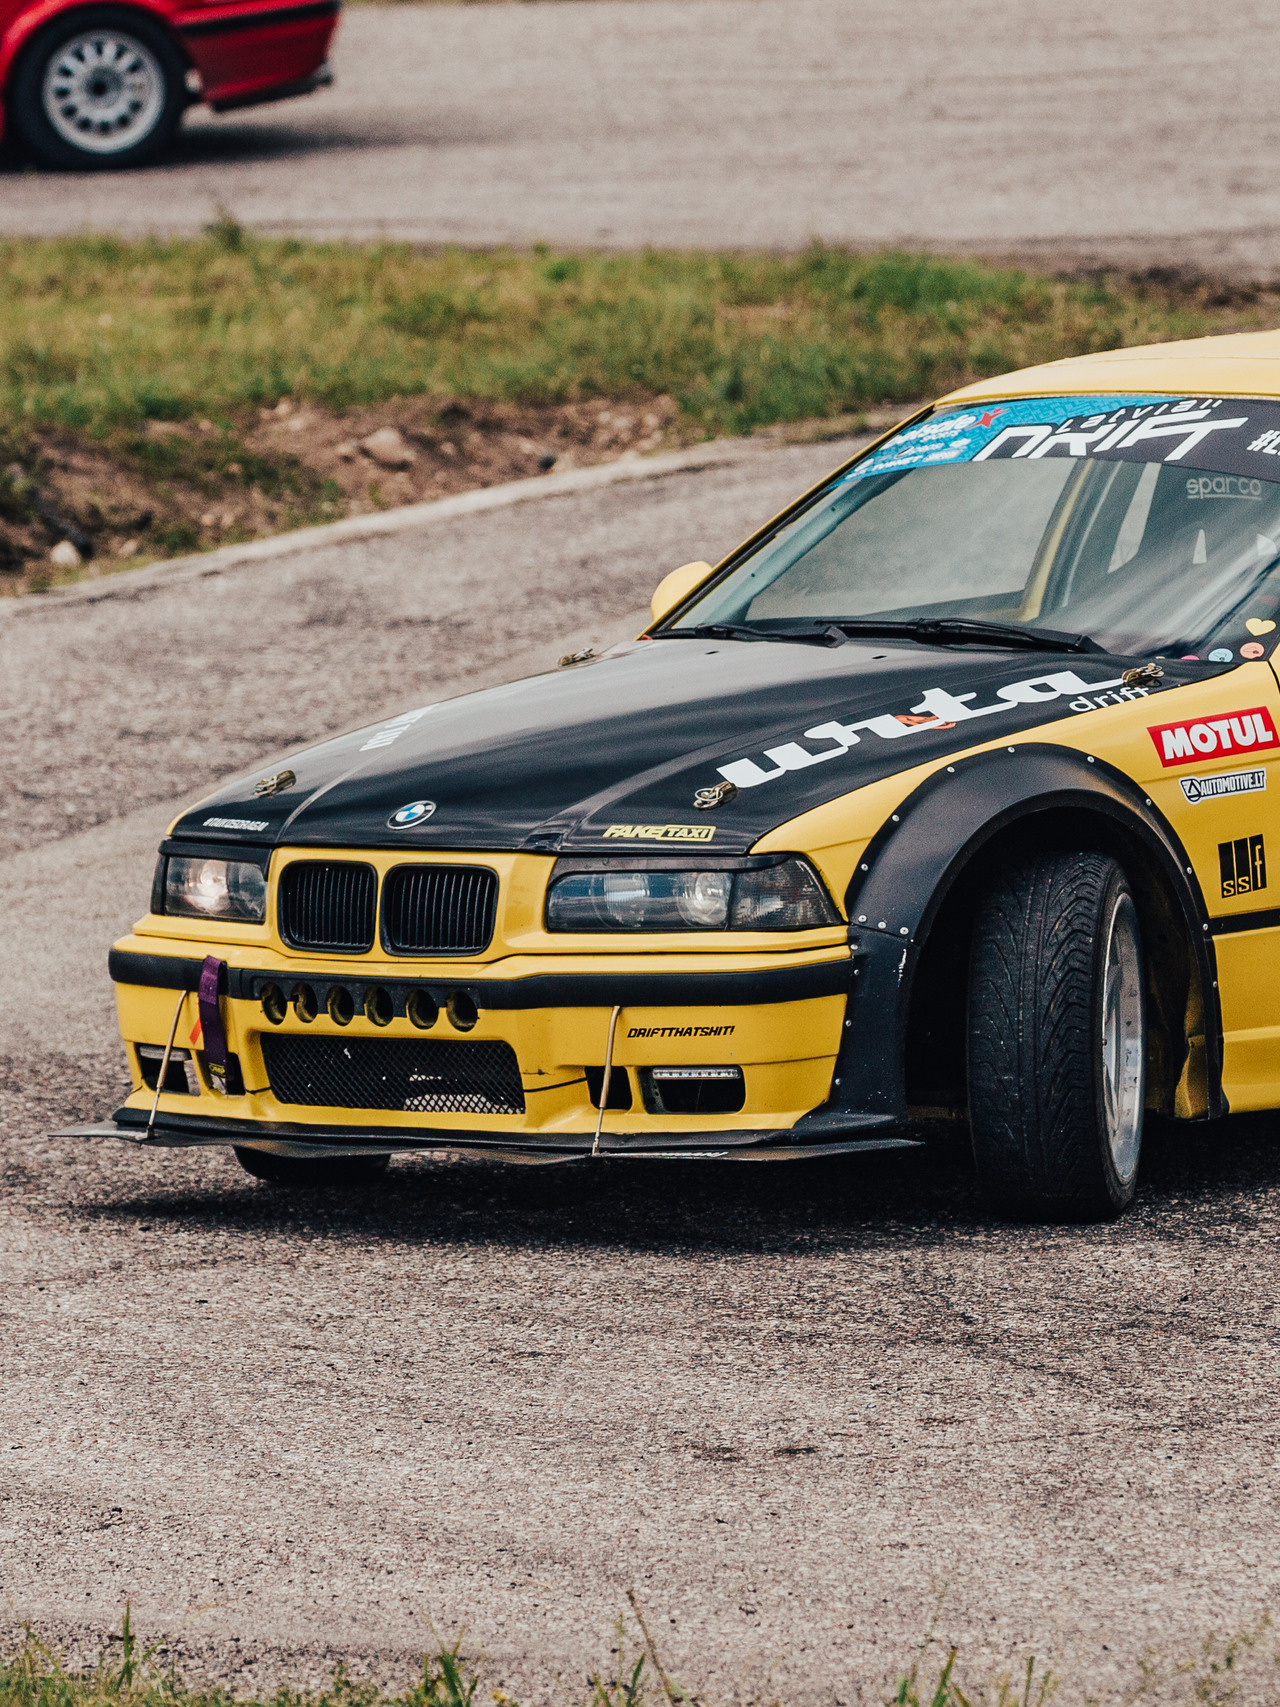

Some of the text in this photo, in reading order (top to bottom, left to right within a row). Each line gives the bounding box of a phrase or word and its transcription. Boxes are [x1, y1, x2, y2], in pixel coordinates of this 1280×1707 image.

[971, 409, 1249, 462] DRIFT
[1185, 476, 1262, 499] sparco
[1069, 687, 1149, 712] drift
[1161, 712, 1273, 760] MOTUL
[627, 1025, 735, 1039] DRIFTTHATSHIT!
